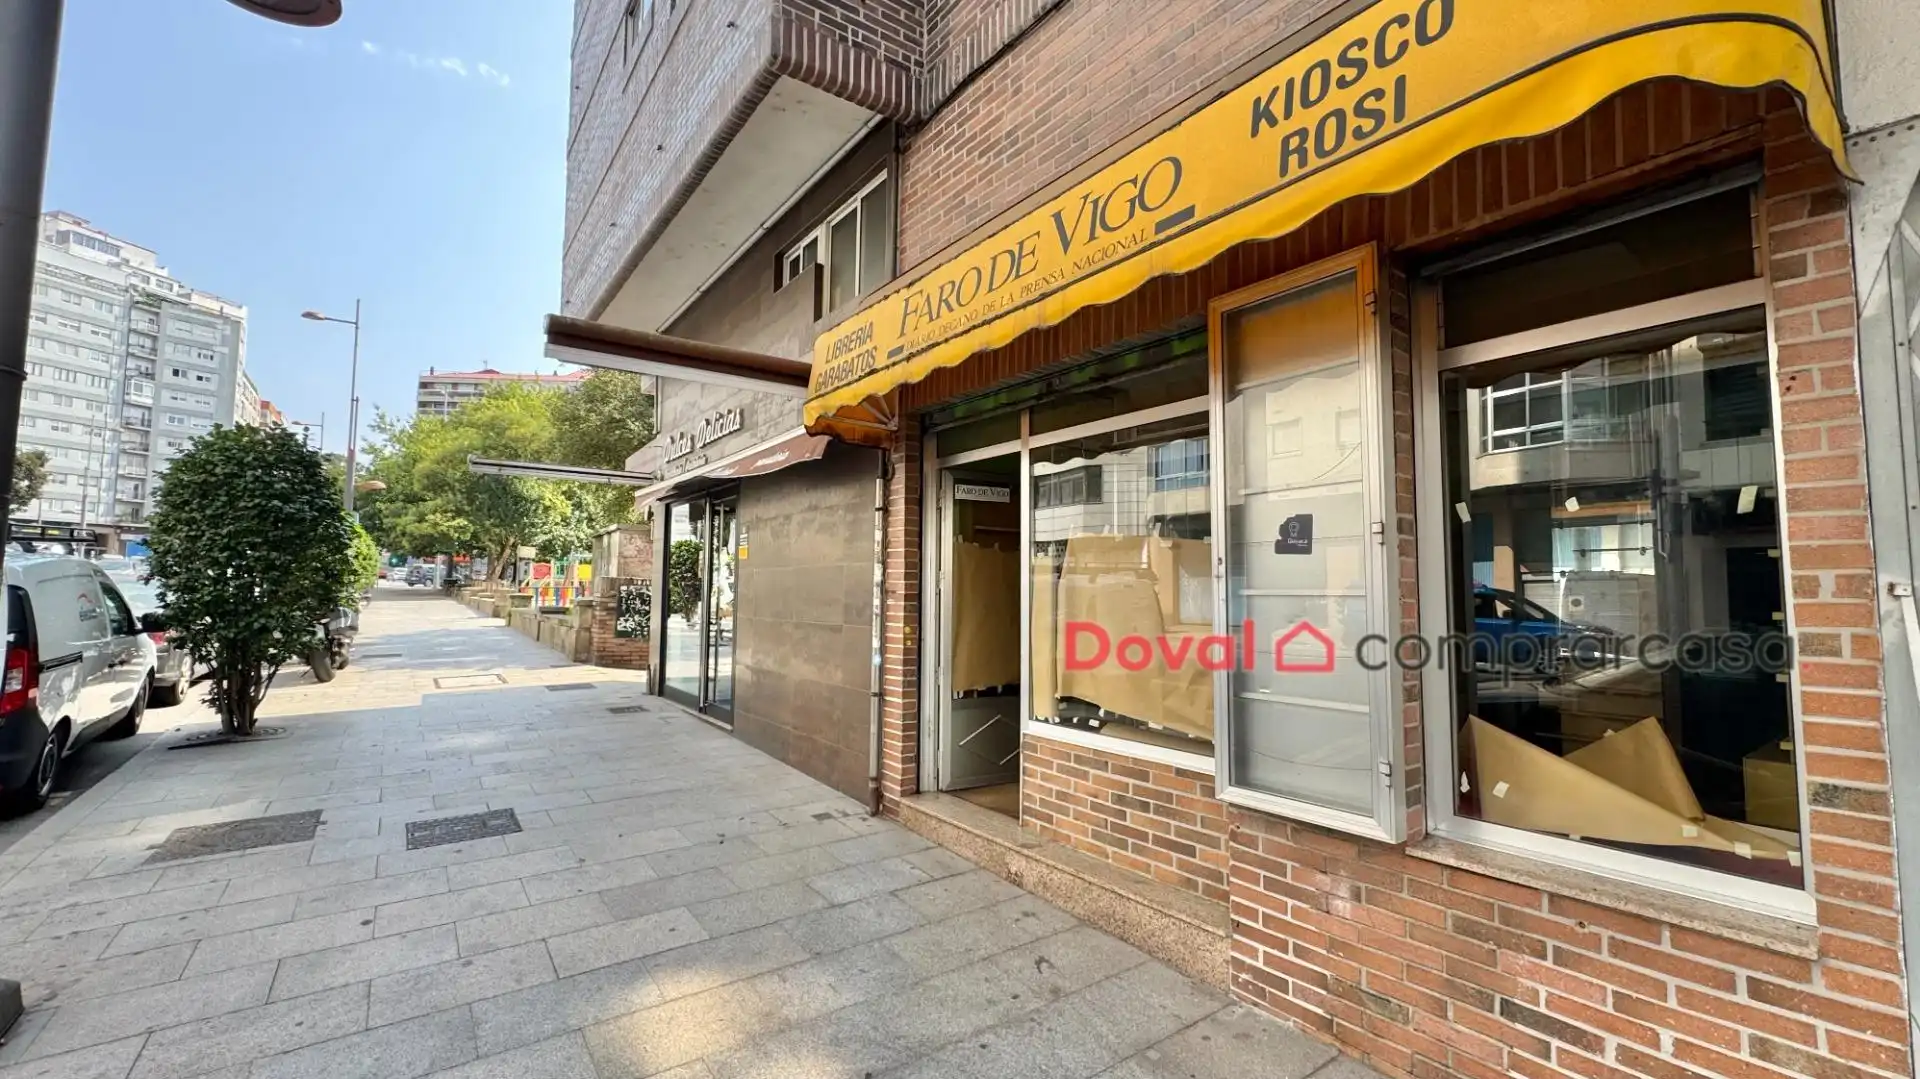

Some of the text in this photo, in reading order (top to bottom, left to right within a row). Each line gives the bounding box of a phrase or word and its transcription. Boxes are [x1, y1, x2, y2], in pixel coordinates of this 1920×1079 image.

[1249, 0, 1455, 138] KIOSCO
[1278, 75, 1407, 177] ROSI
[898, 155, 1183, 340] FARO DE VIGO
[905, 330, 936, 351] DIARIO
[982, 301, 997, 316] DE
[1000, 292, 1015, 309] LA
[1020, 267, 1066, 299] PRENSA
[1072, 228, 1149, 275] NACIONAL
[815, 345, 878, 393] GARABATOS
[697, 407, 744, 449] Delicias
